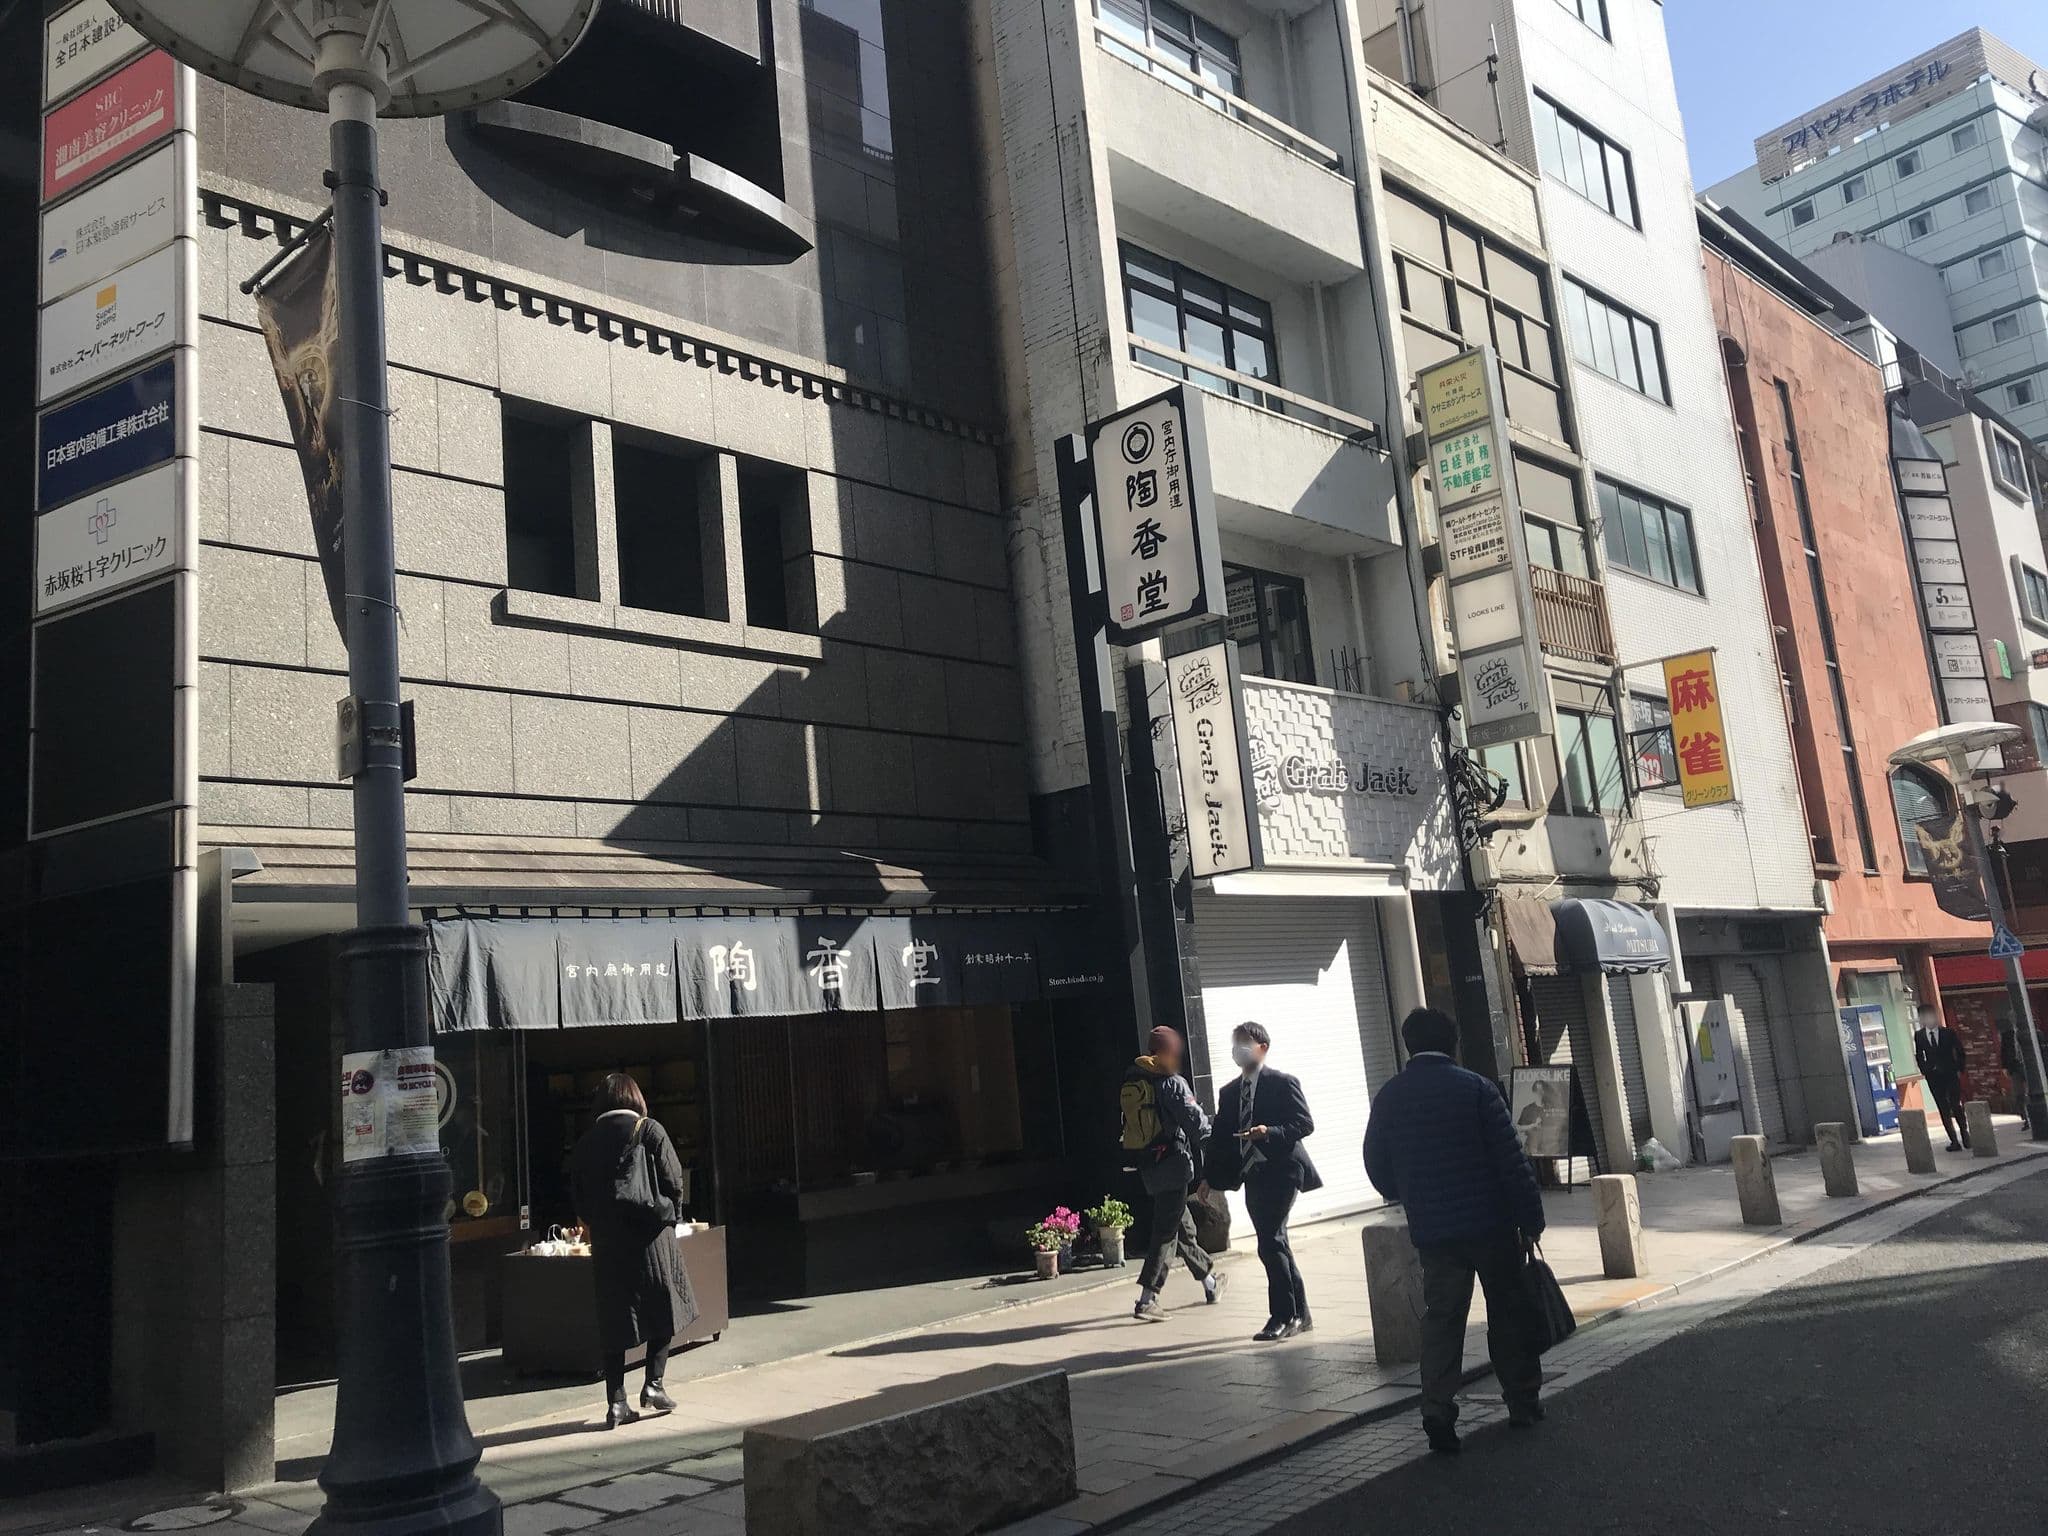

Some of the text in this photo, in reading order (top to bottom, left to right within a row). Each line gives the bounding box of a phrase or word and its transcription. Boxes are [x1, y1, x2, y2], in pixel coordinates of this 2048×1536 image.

[56, 88, 164, 166] 湘南美容クリニック
[46, 401, 169, 470] 日本室内設備工業株式会社
[1440, 445, 1490, 474] 日経財務
[1445, 433, 1480, 454] 株式会社
[1161, 420, 1183, 510] 宮内庁御用達
[1443, 463, 1492, 491] 不動産鑑定
[1470, 483, 1482, 494] 4F
[44, 536, 166, 597] 赤坂桜十字クリニック
[1125, 469, 1169, 617] 陶香堂
[1497, 553, 1509, 563] 3F
[1467, 604, 1505, 619] LOOKS LIKE
[1518, 702, 1529, 711] 1F
[1670, 669, 1724, 776] 麻雀
[1195, 718, 1228, 866] Grab Jack
[1285, 755, 1418, 795] Grab Jack
[708, 936, 941, 992] 陶香堂
